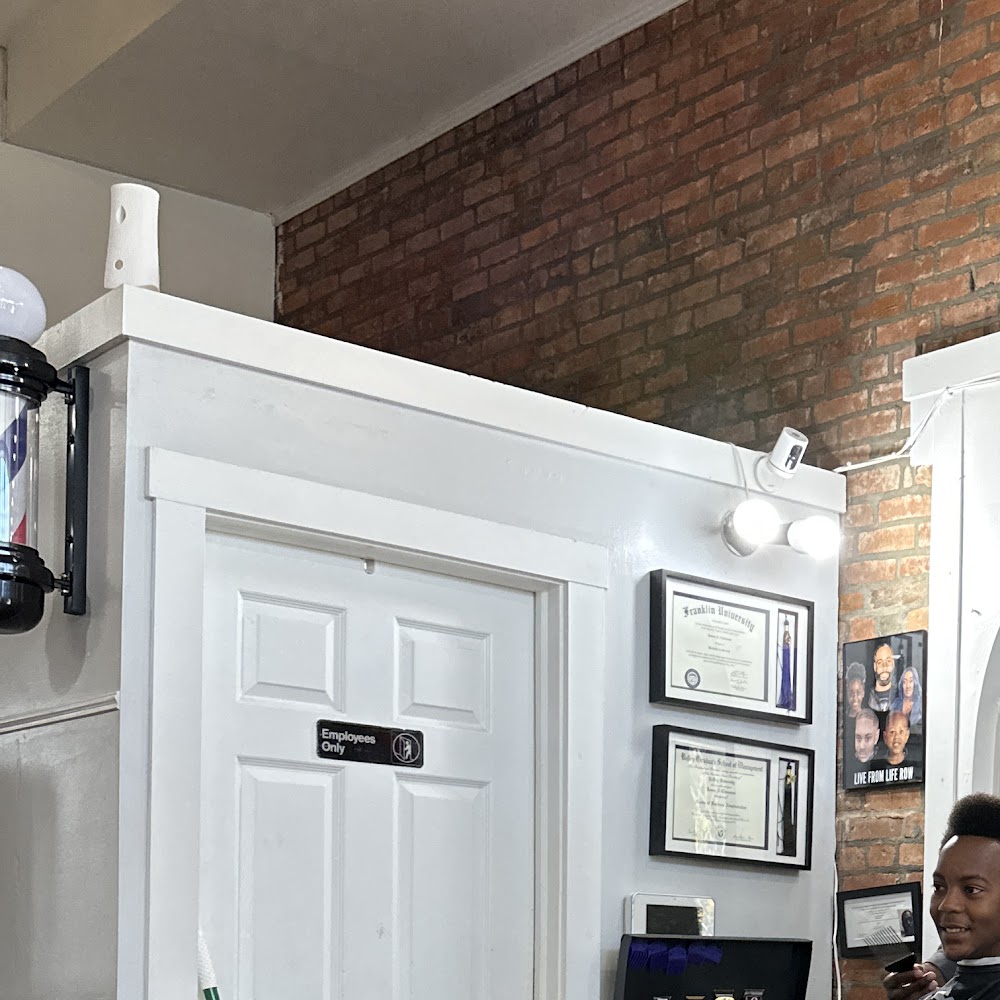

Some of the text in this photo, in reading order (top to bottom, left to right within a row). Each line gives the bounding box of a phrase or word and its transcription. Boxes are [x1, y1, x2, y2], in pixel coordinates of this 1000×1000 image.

[683, 604, 716, 617] Franklin
[718, 605, 755, 632] University
[321, 728, 376, 745] Employees
[321, 741, 346, 755] Only
[854, 766, 914, 785] LIVE FROM LIFE ROW
